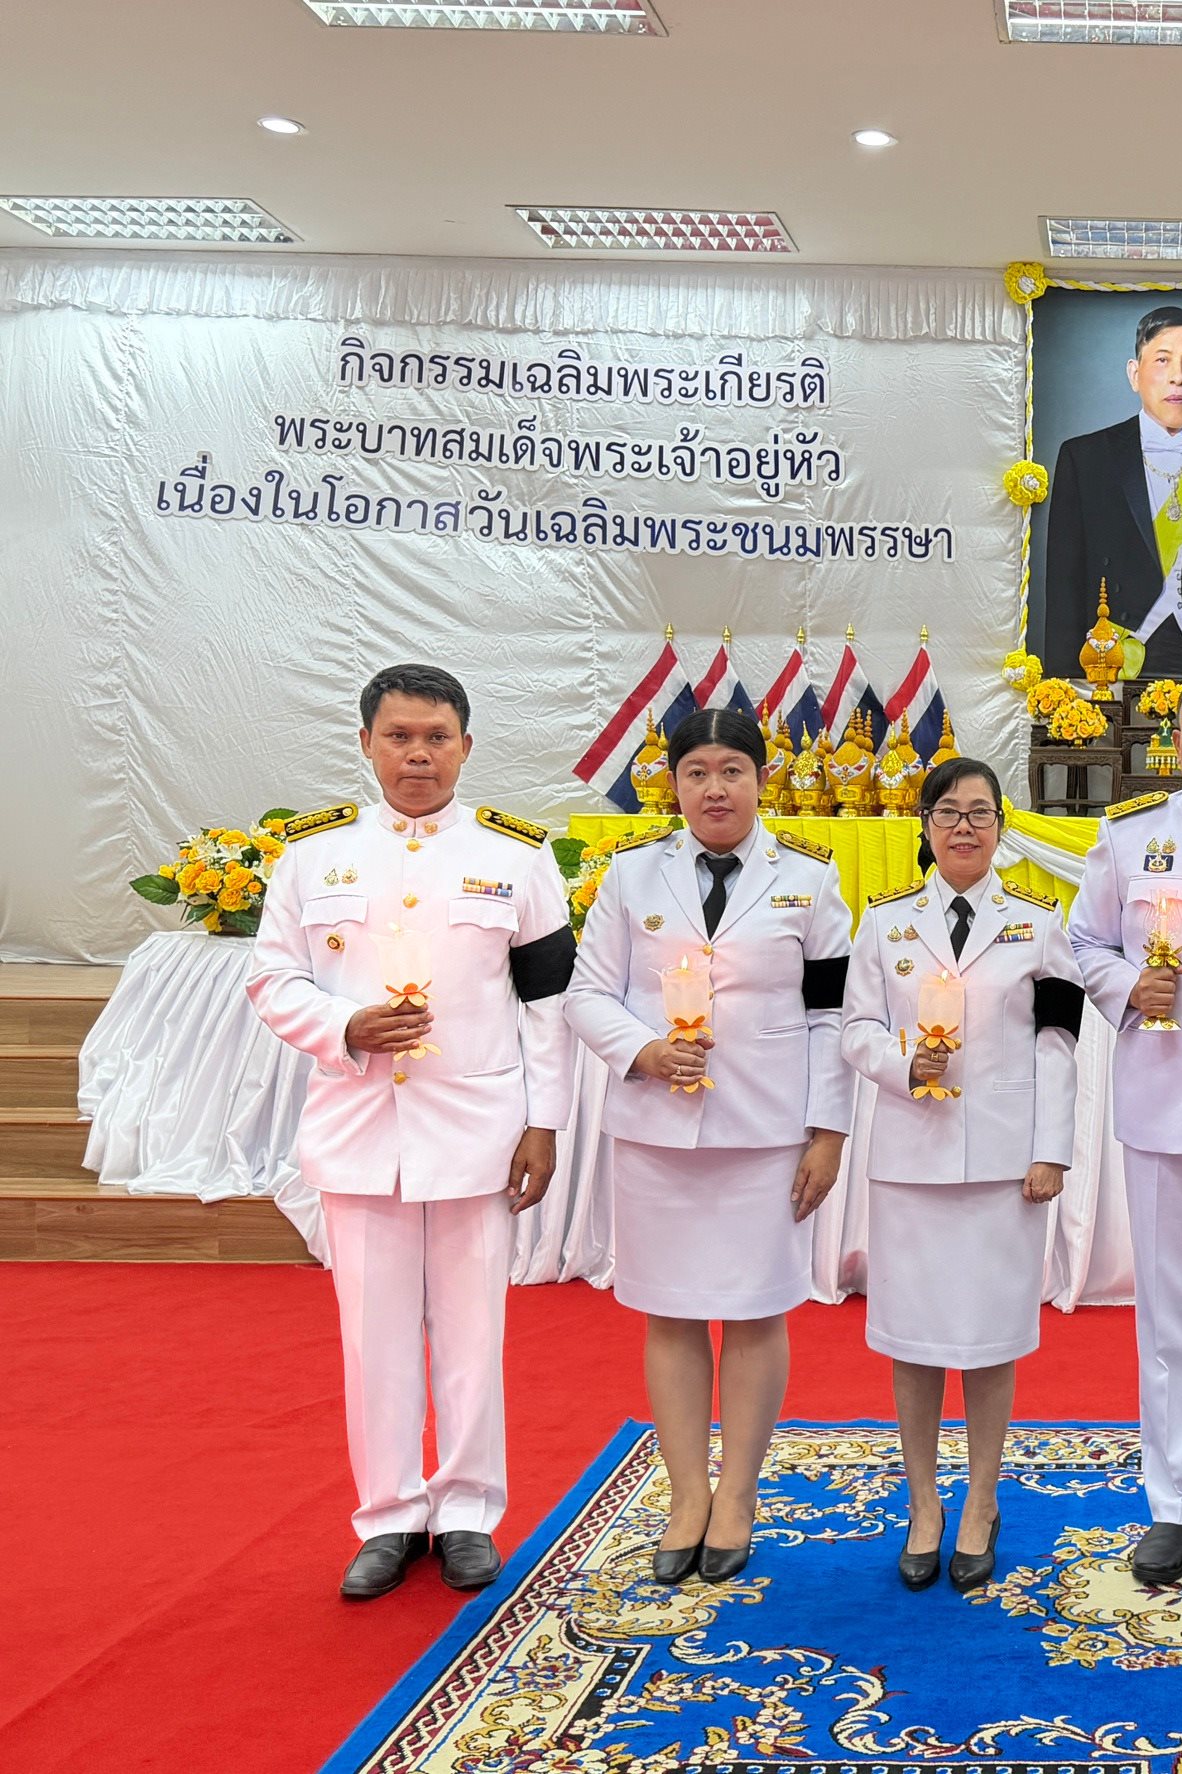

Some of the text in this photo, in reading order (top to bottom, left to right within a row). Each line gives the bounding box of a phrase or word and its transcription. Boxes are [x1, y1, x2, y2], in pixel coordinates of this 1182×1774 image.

[339, 336, 825, 404] กิจกรรมเฉลิมพระเกียรติ
[274, 414, 842, 496] พระบาทสมเด็จพระเจ้าอยู่หัว
